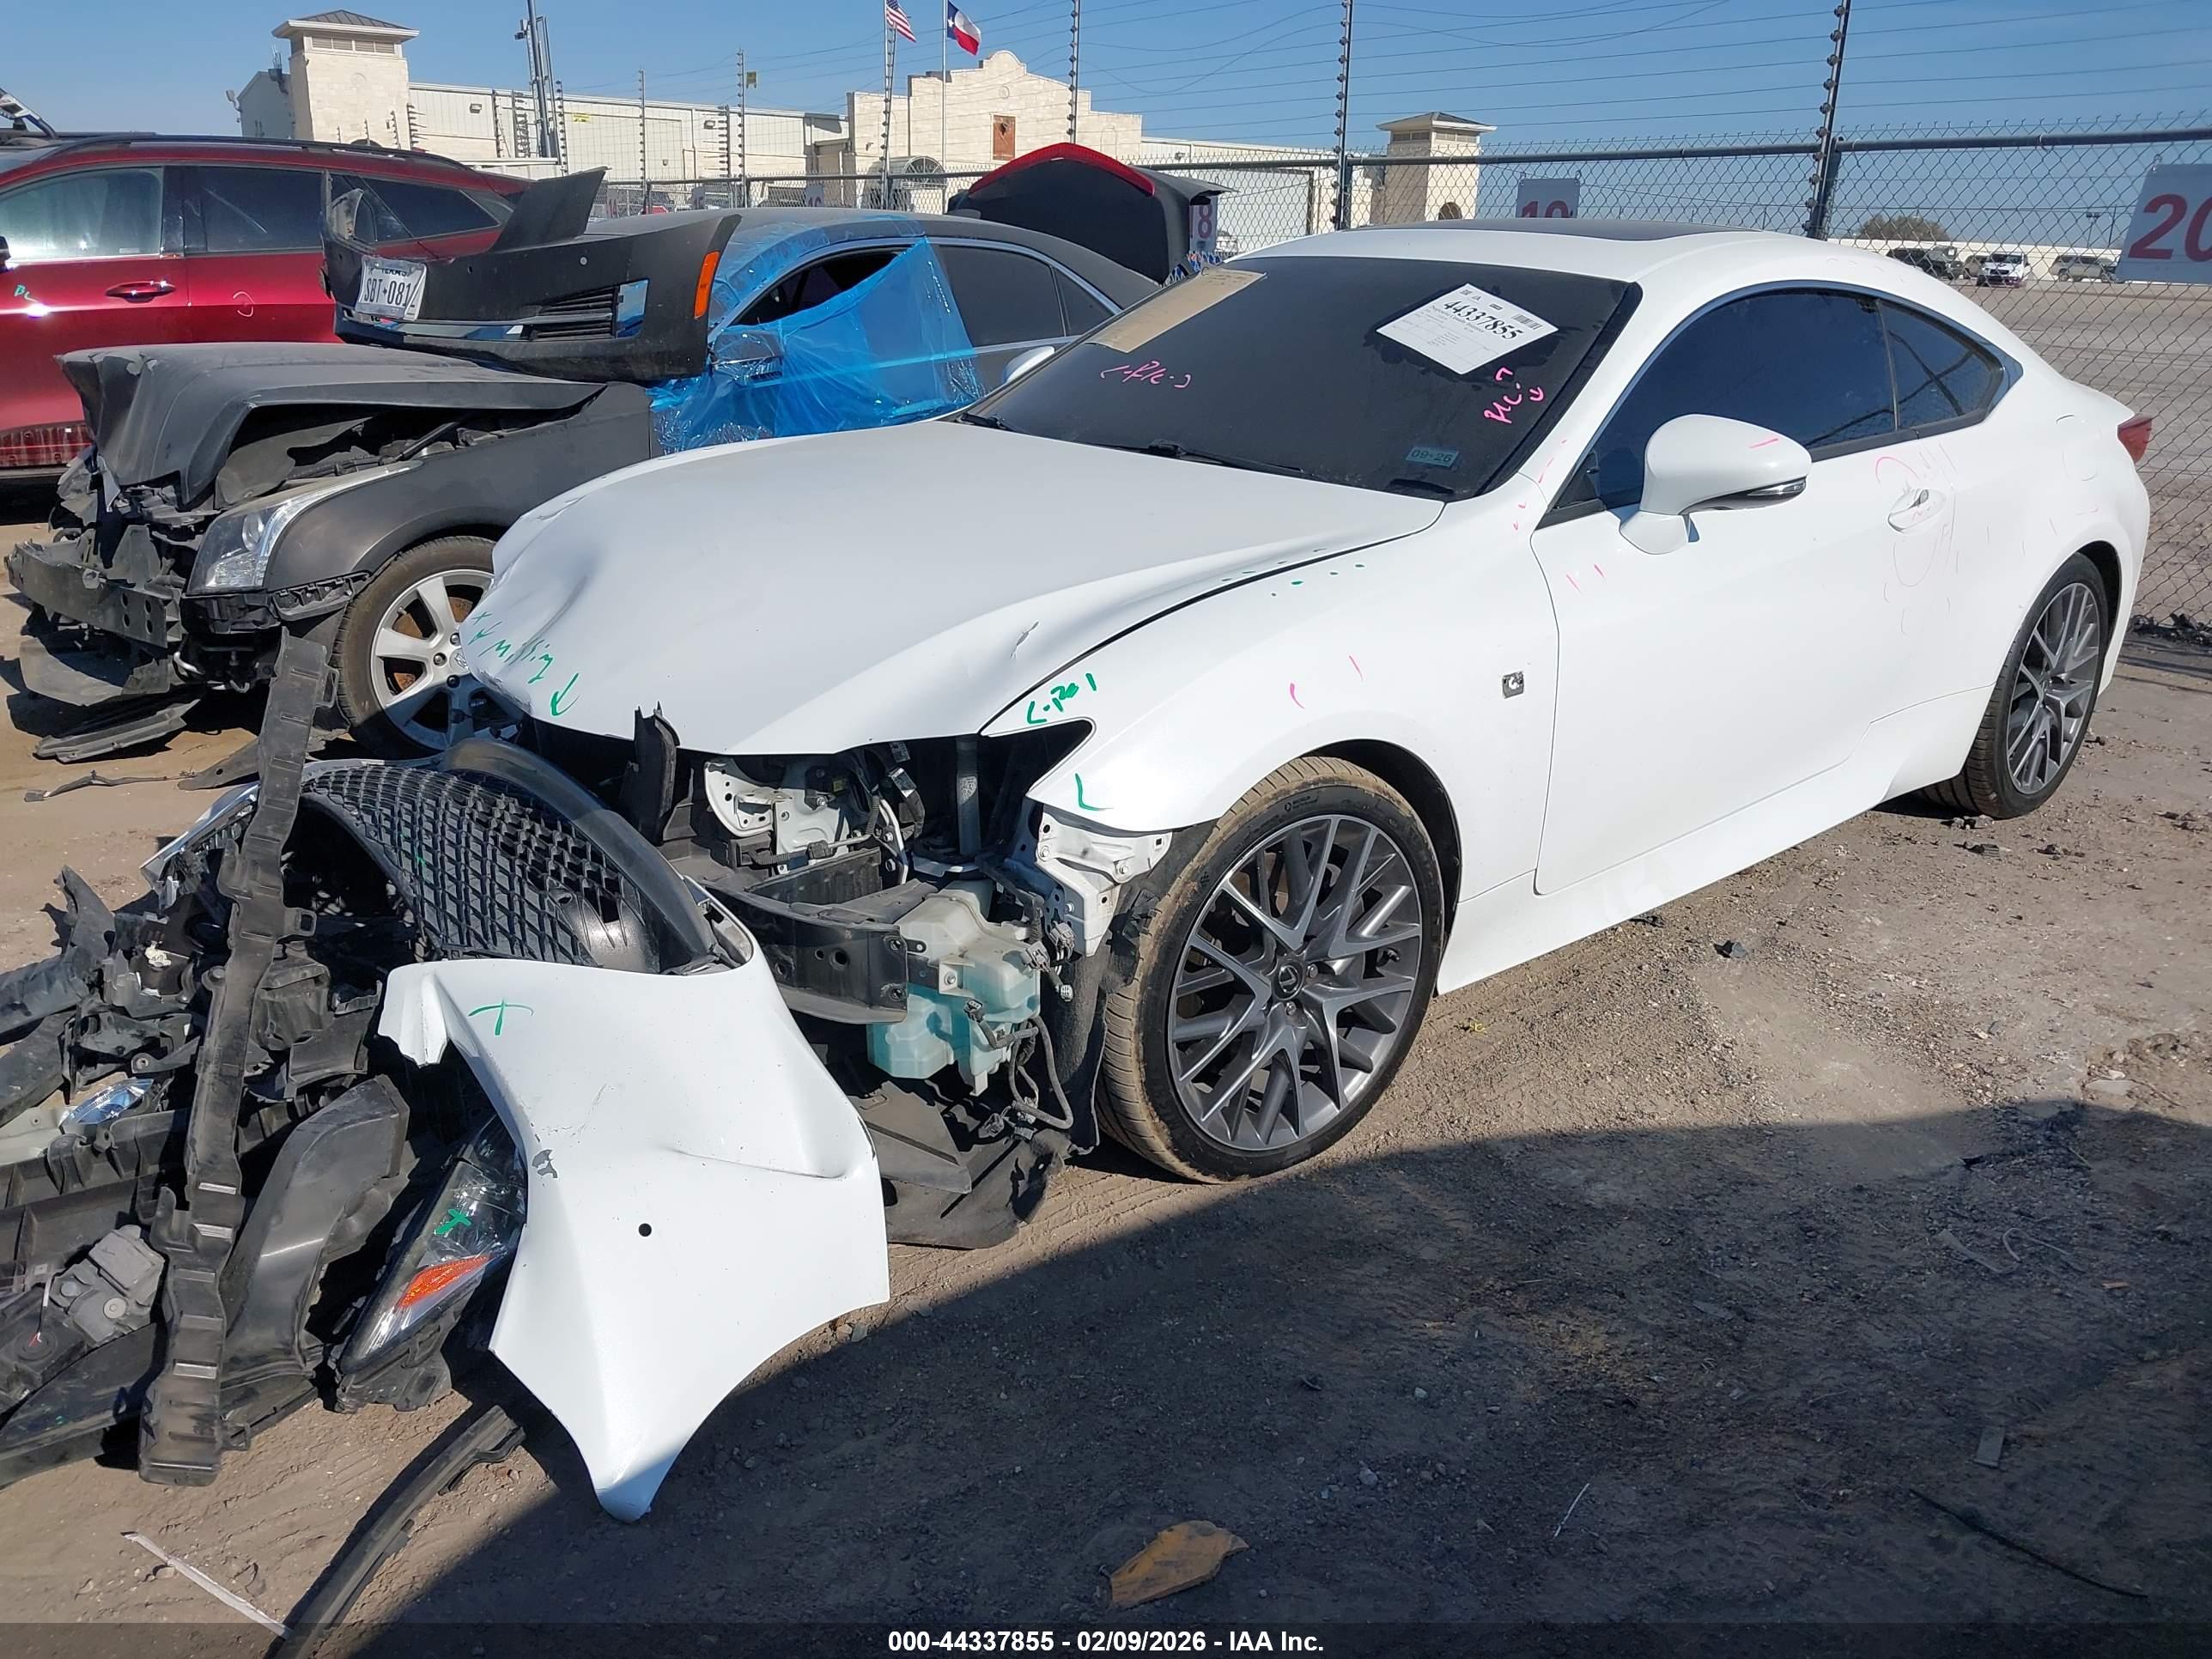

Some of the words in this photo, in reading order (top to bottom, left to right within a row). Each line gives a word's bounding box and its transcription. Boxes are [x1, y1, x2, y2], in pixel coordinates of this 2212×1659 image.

[1188, 196, 1212, 239] 8
[364, 277, 383, 303] SBT
[1443, 301, 1524, 340] 44337855
